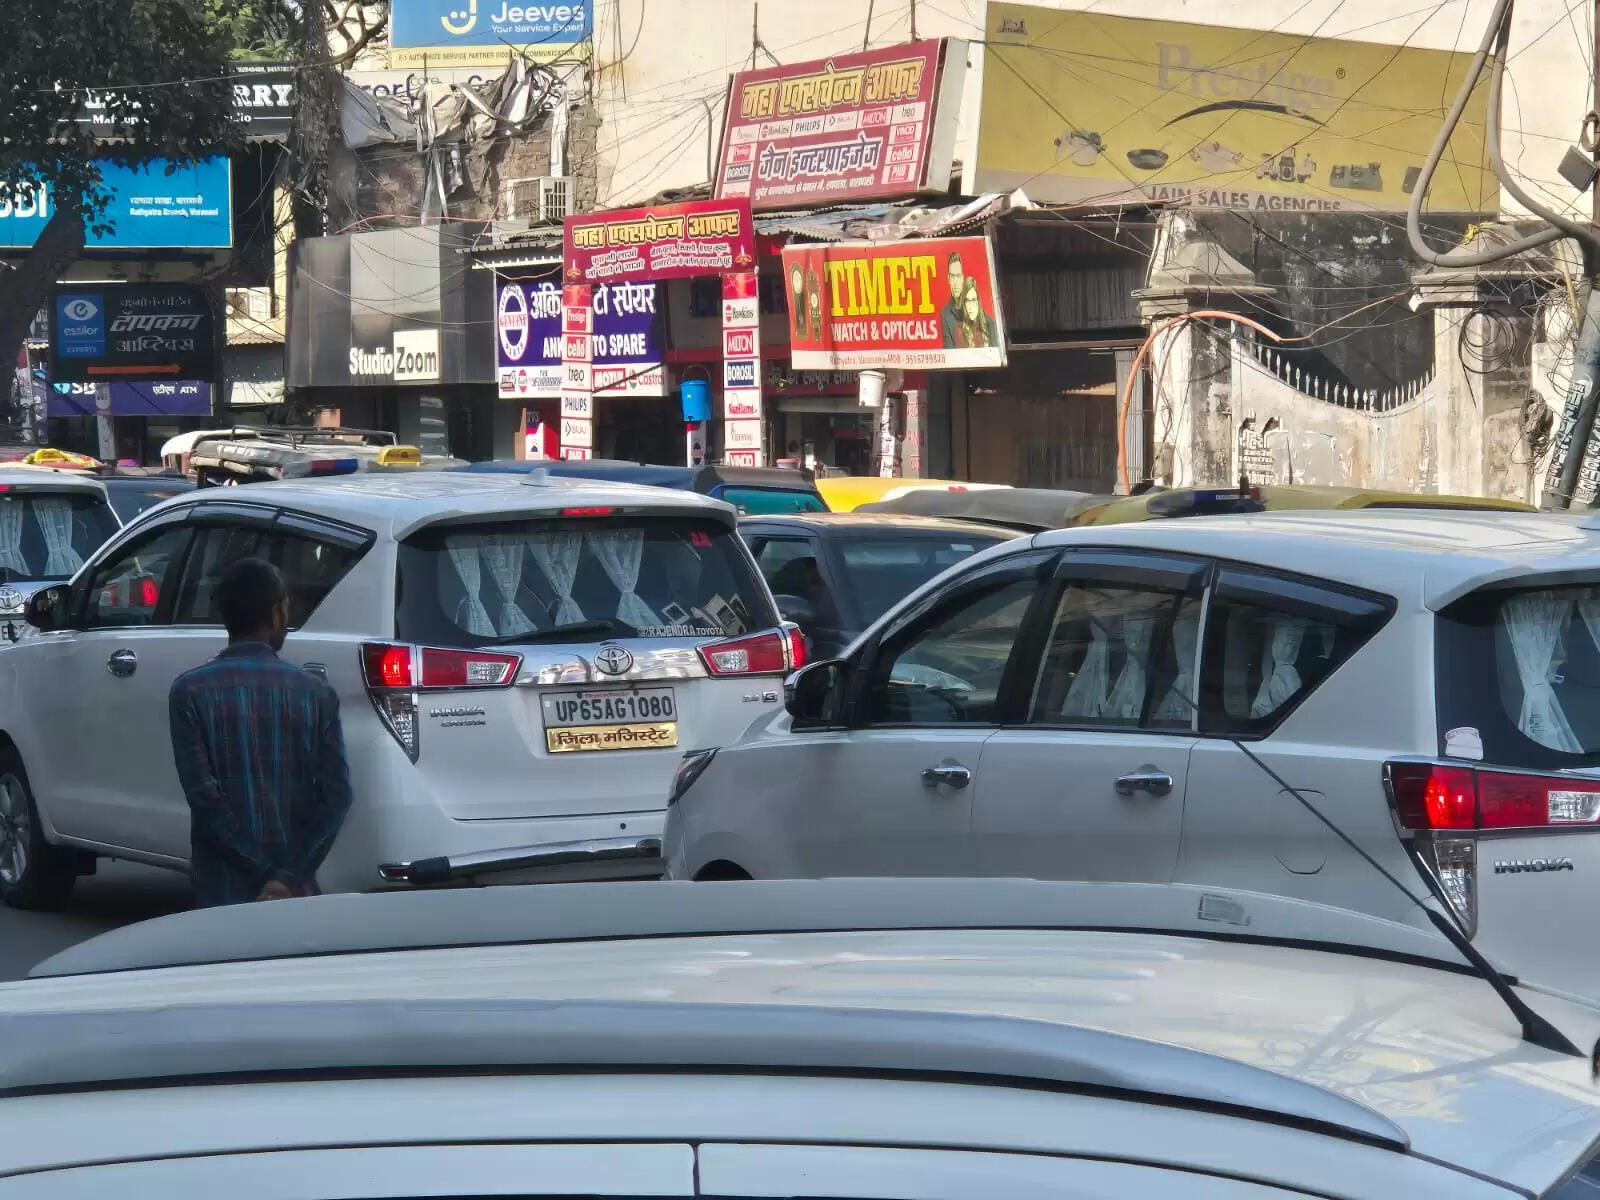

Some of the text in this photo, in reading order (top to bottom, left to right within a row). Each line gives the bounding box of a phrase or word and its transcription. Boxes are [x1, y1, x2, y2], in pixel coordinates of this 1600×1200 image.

[491, 2, 586, 23] Jeeves
[491, 25, 512, 33] Your
[553, 23, 585, 32] Expert
[1156, 42, 1336, 113] Prestige
[795, 120, 821, 133] PHILIPS
[1148, 186, 1341, 211] JAIN SALES AGENCIES
[572, 225, 607, 249] महा
[687, 209, 741, 240] आफर
[824, 255, 937, 317] TIMET
[64, 326, 99, 337] essilor
[831, 319, 938, 342] WATCH & OPTICALS
[610, 333, 647, 356] SPARE
[727, 335, 753, 352] MILTON
[349, 347, 393, 375] Studio
[395, 345, 438, 375] Zoom
[568, 366, 585, 382] treo
[727, 364, 754, 381] BOROSIL
[180, 385, 198, 394] ATM
[565, 396, 587, 412] PHILIPS
[648, 624, 696, 638] RAJENDRA
[696, 627, 726, 637] TOYOTA
[555, 695, 673, 722] UP65AG1080
[1494, 856, 1575, 875] INNOVA
